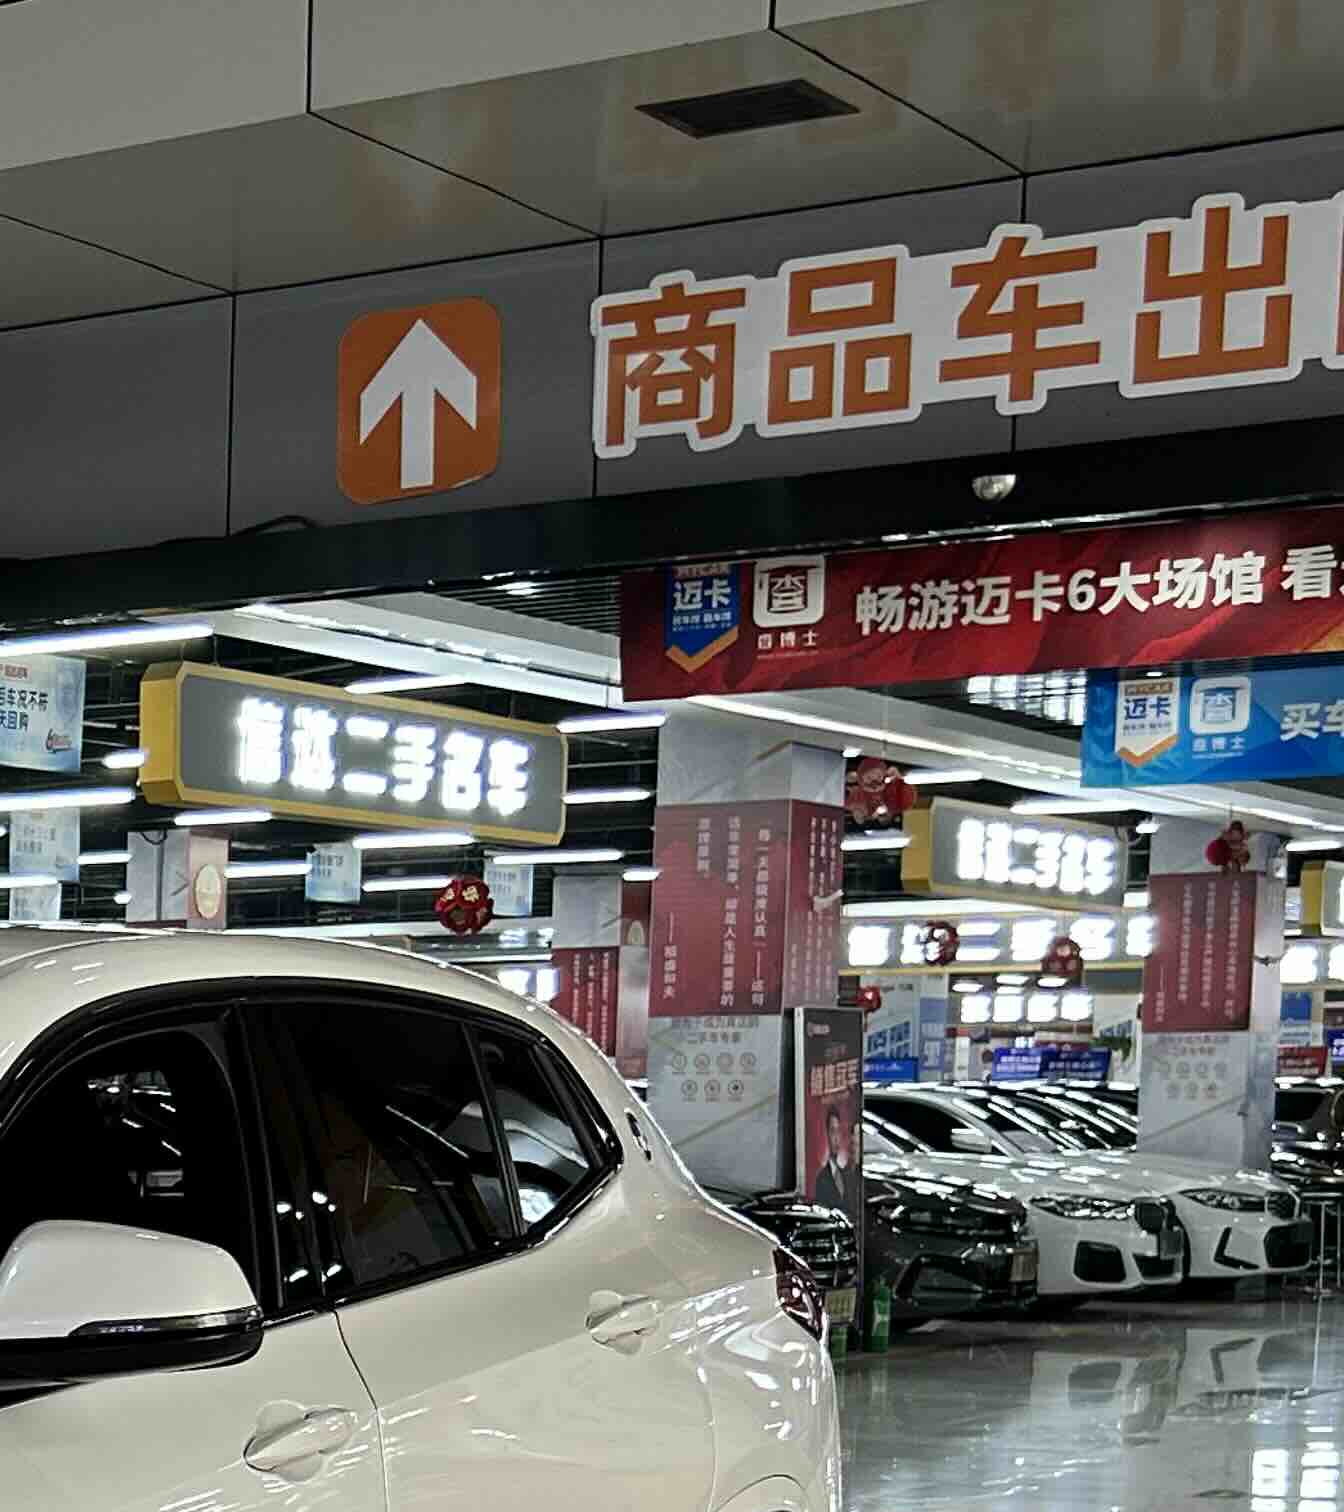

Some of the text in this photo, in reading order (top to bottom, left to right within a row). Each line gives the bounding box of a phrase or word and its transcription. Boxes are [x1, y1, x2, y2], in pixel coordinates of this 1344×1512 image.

[598, 204, 1344, 448] 商品车出
[672, 578, 731, 611] 迈卡
[856, 551, 1266, 636] 畅游迈卡6大场馆
[1124, 696, 1171, 721] 迈卡
